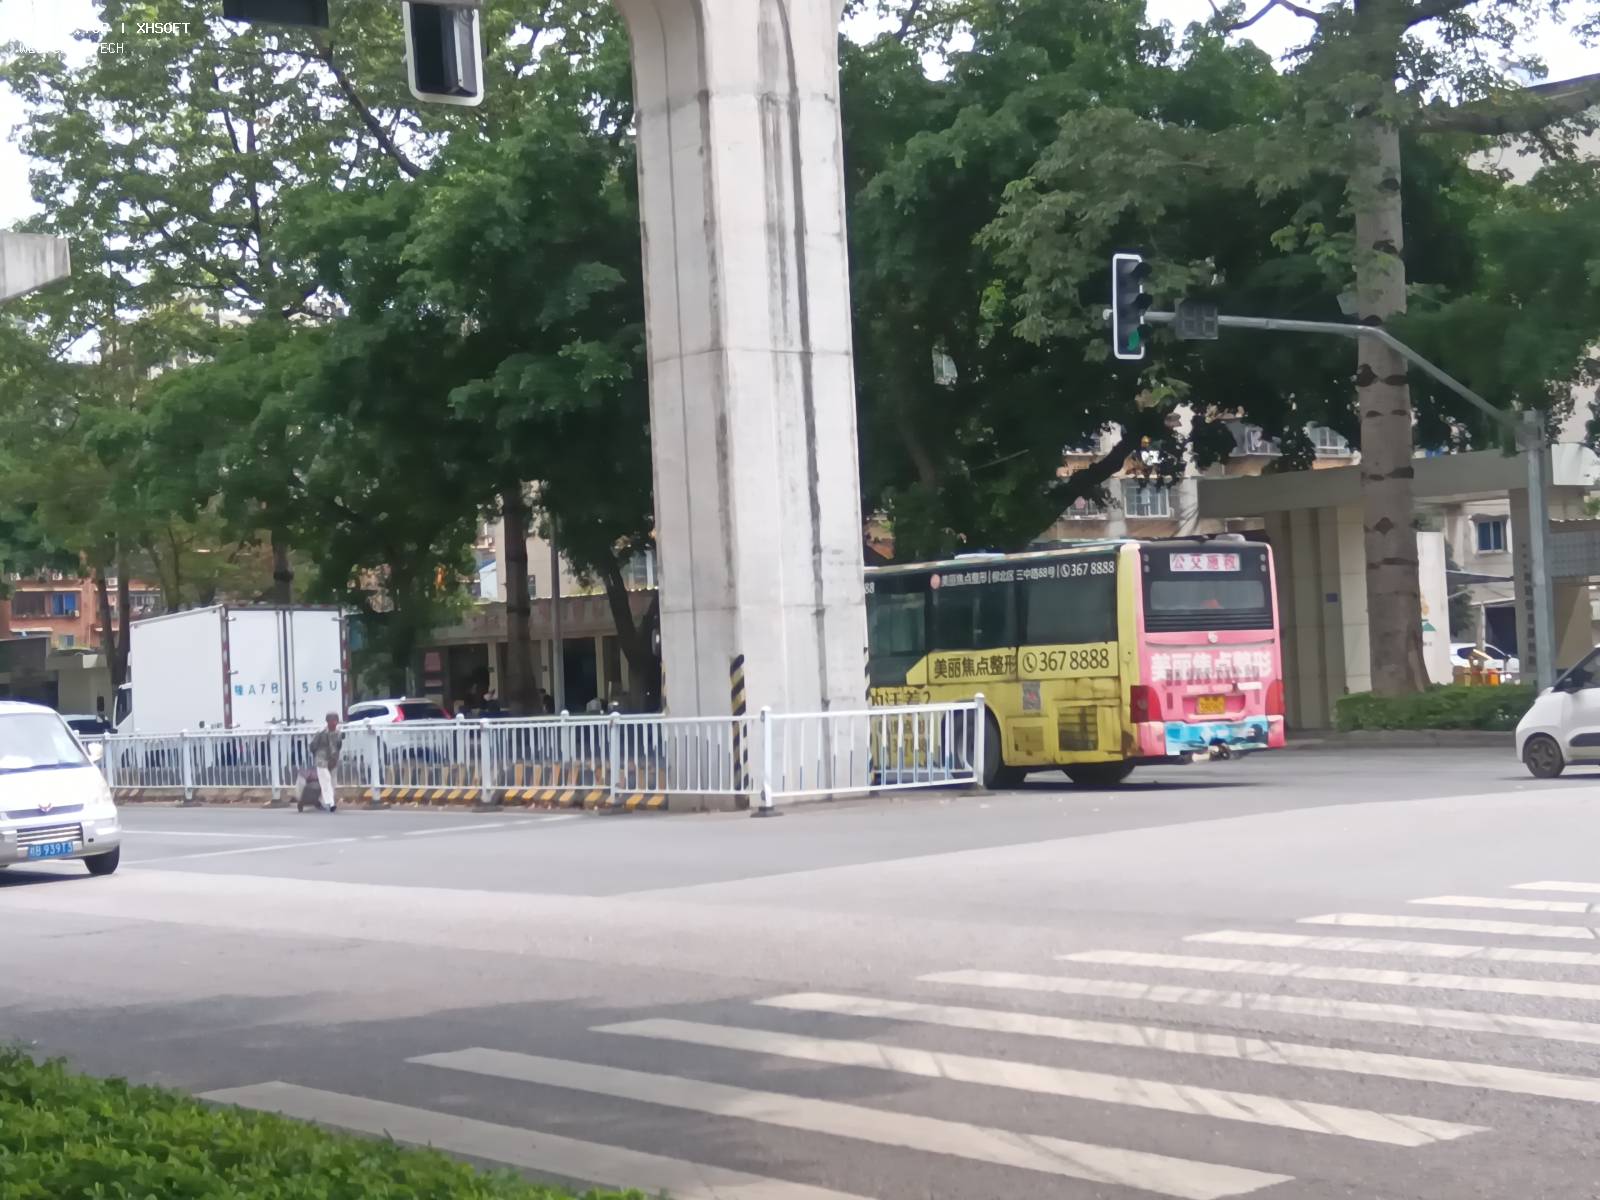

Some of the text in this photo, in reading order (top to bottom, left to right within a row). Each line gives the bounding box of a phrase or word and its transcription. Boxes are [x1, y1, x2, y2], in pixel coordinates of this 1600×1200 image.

[1070, 563, 1088, 576] 367
[1090, 561, 1115, 575] 8888
[934, 648, 1110, 679] 美丽焦点整形 367 8888
